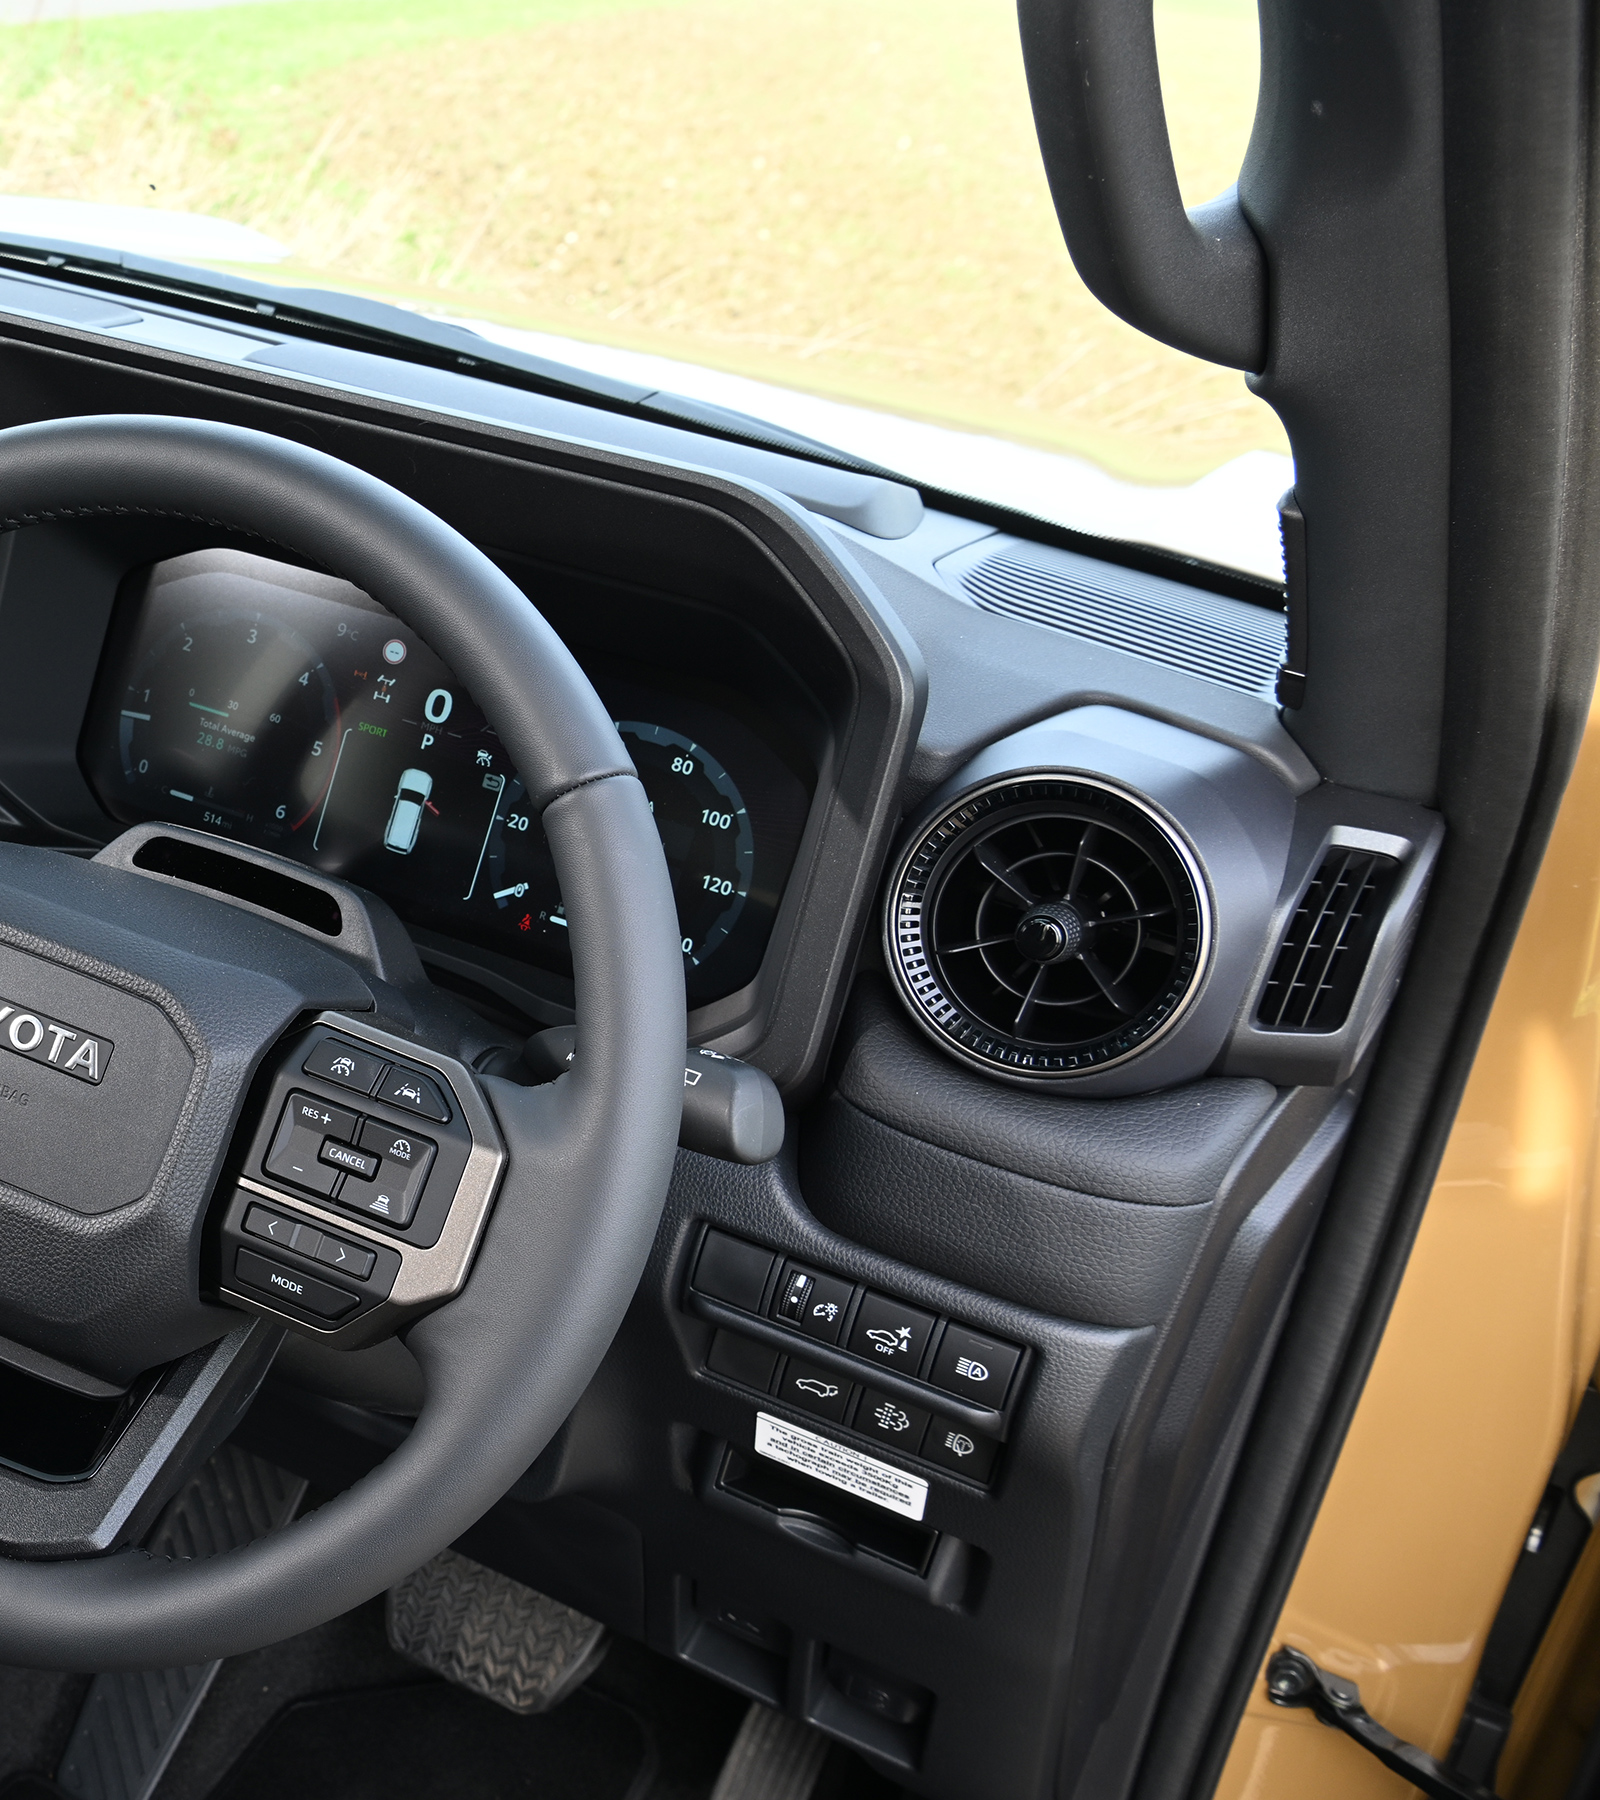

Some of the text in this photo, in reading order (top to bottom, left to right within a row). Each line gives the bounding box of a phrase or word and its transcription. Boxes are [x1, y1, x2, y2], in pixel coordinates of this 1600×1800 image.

[182, 636, 194, 653] 2
[246, 628, 258, 645] 3
[298, 671, 310, 687] 4
[143, 688, 151, 703] 1
[188, 687, 196, 698] 0
[227, 699, 240, 711] 30
[423, 688, 454, 725] 0
[269, 712, 282, 724] 60
[199, 717, 256, 744] Total Average
[357, 720, 389, 739] SPORT
[420, 721, 444, 736] MPH
[196, 731, 225, 751] 28.8
[311, 740, 324, 757] 5
[420, 732, 435, 751] P
[137, 758, 149, 774] 0
[671, 756, 694, 777] 80
[202, 810, 222, 827] 514
[275, 804, 287, 820] 6
[701, 808, 732, 831] 100
[507, 813, 530, 832] 20
[513, 883, 526, 899] 0
[702, 874, 733, 897] 120
[301, 1105, 320, 1120] RES
[327, 1147, 366, 1171] CANCEL
[388, 1147, 412, 1161] MODE
[270, 1272, 304, 1296] MODE
[874, 1342, 895, 1356] OFF
[770, 1424, 789, 1436] The
[790, 1434, 819, 1449] gross
[820, 1446, 844, 1460] train
[845, 1457, 879, 1474] weight
[894, 1477, 914, 1489] this
[782, 1436, 816, 1454] vehicle
[818, 1452, 859, 1472] exceeds
[769, 1437, 788, 1448] and
[790, 1445, 800, 1454] in
[802, 1450, 836, 1468] certain
[837, 1465, 910, 1500] circumstances
[775, 1444, 830, 1472] tachograph
[832, 1469, 852, 1482] may
[854, 1478, 868, 1488] be
[869, 1485, 912, 1507] required
[786, 1455, 813, 1470] when
[815, 1467, 848, 1486] towing
